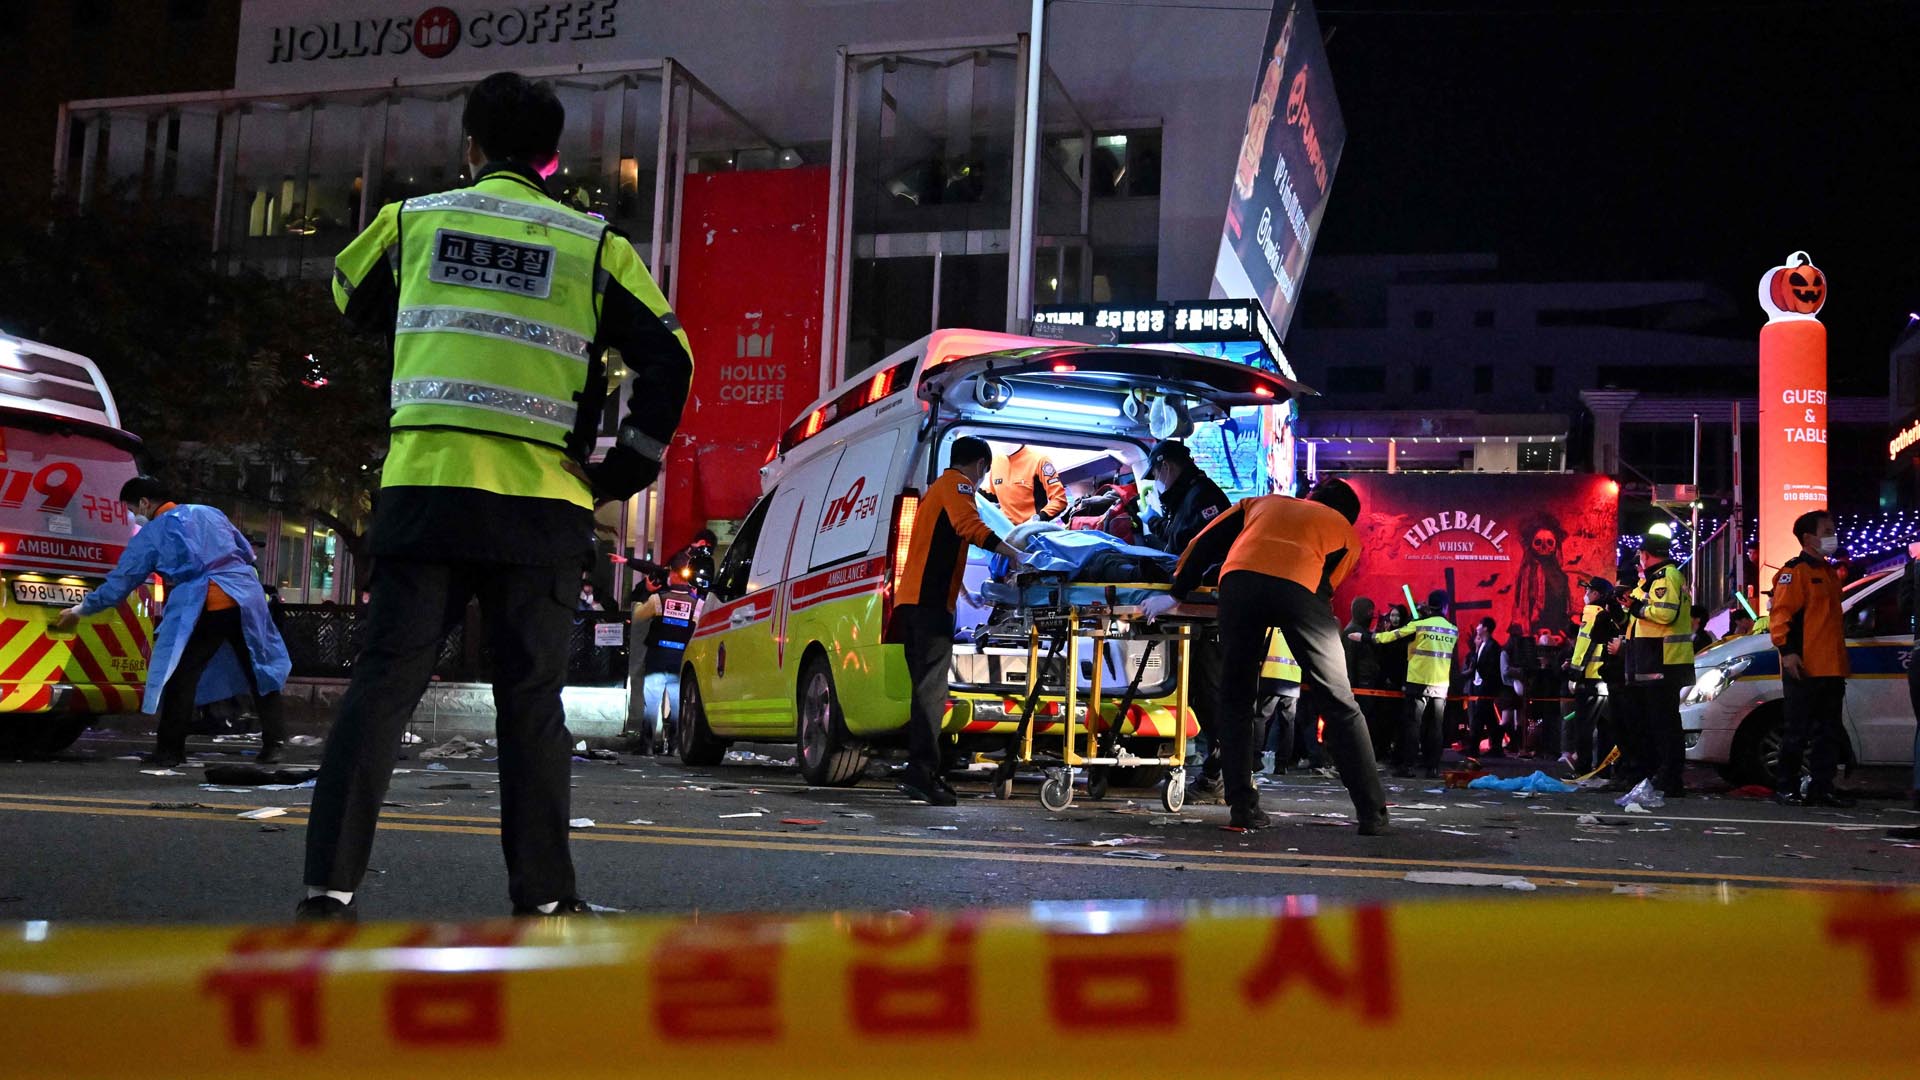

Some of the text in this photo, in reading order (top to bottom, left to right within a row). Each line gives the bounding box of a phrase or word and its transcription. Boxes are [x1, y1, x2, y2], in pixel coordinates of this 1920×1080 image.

[268, 0, 618, 64] HOLLYS COFFEE
[444, 237, 545, 274] 교통경찰
[444, 265, 537, 291] POLICE
[720, 364, 787, 381] HOLLYS
[720, 384, 785, 401] COFFEE
[1782, 389, 1827, 406] GUEST
[1804, 408, 1816, 423] &
[1783, 427, 1827, 444] TABLE
[1889, 419, 1920, 461] gatheri
[82, 494, 128, 526] 구급대
[820, 476, 879, 533] 119 구급대
[1403, 511, 1509, 550] FIREBALL
[16, 538, 103, 561] AMBULANCE
[1438, 541, 1475, 552] WHISKY
[827, 564, 866, 586] AMBULANCE
[1423, 633, 1455, 643] POLICE
